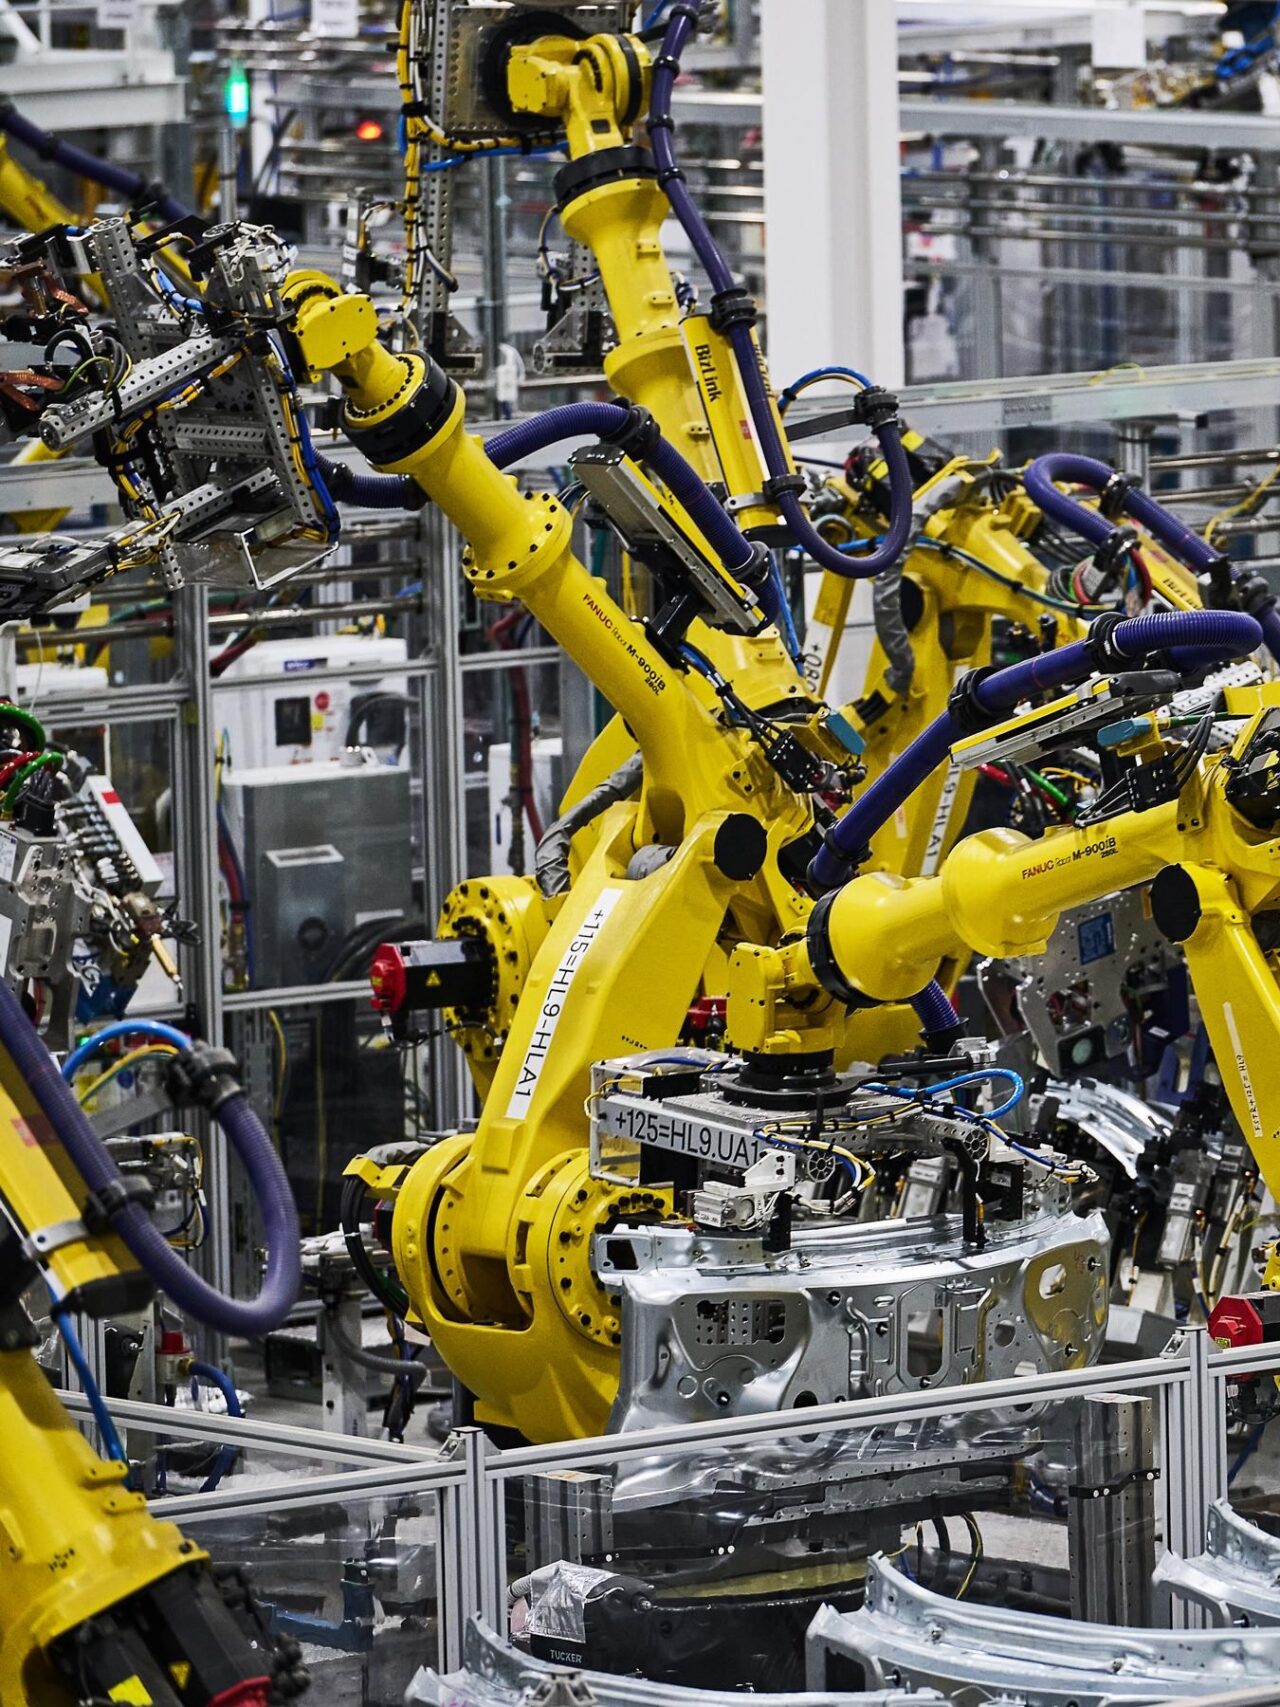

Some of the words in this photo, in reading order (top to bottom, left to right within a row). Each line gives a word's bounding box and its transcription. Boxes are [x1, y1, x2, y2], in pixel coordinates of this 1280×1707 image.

[695, 344, 722, 402] BizLink
[583, 593, 613, 629] FANUC
[626, 644, 666, 691] M-900iB
[1022, 860, 1054, 880] FANUC
[1072, 834, 1117, 862] M-900iB
[515, 909, 603, 1097] +115=HL9-HLA1
[615, 1109, 759, 1167] +125=HL9.UA1
[550, 1649, 582, 1664] TUCKER
